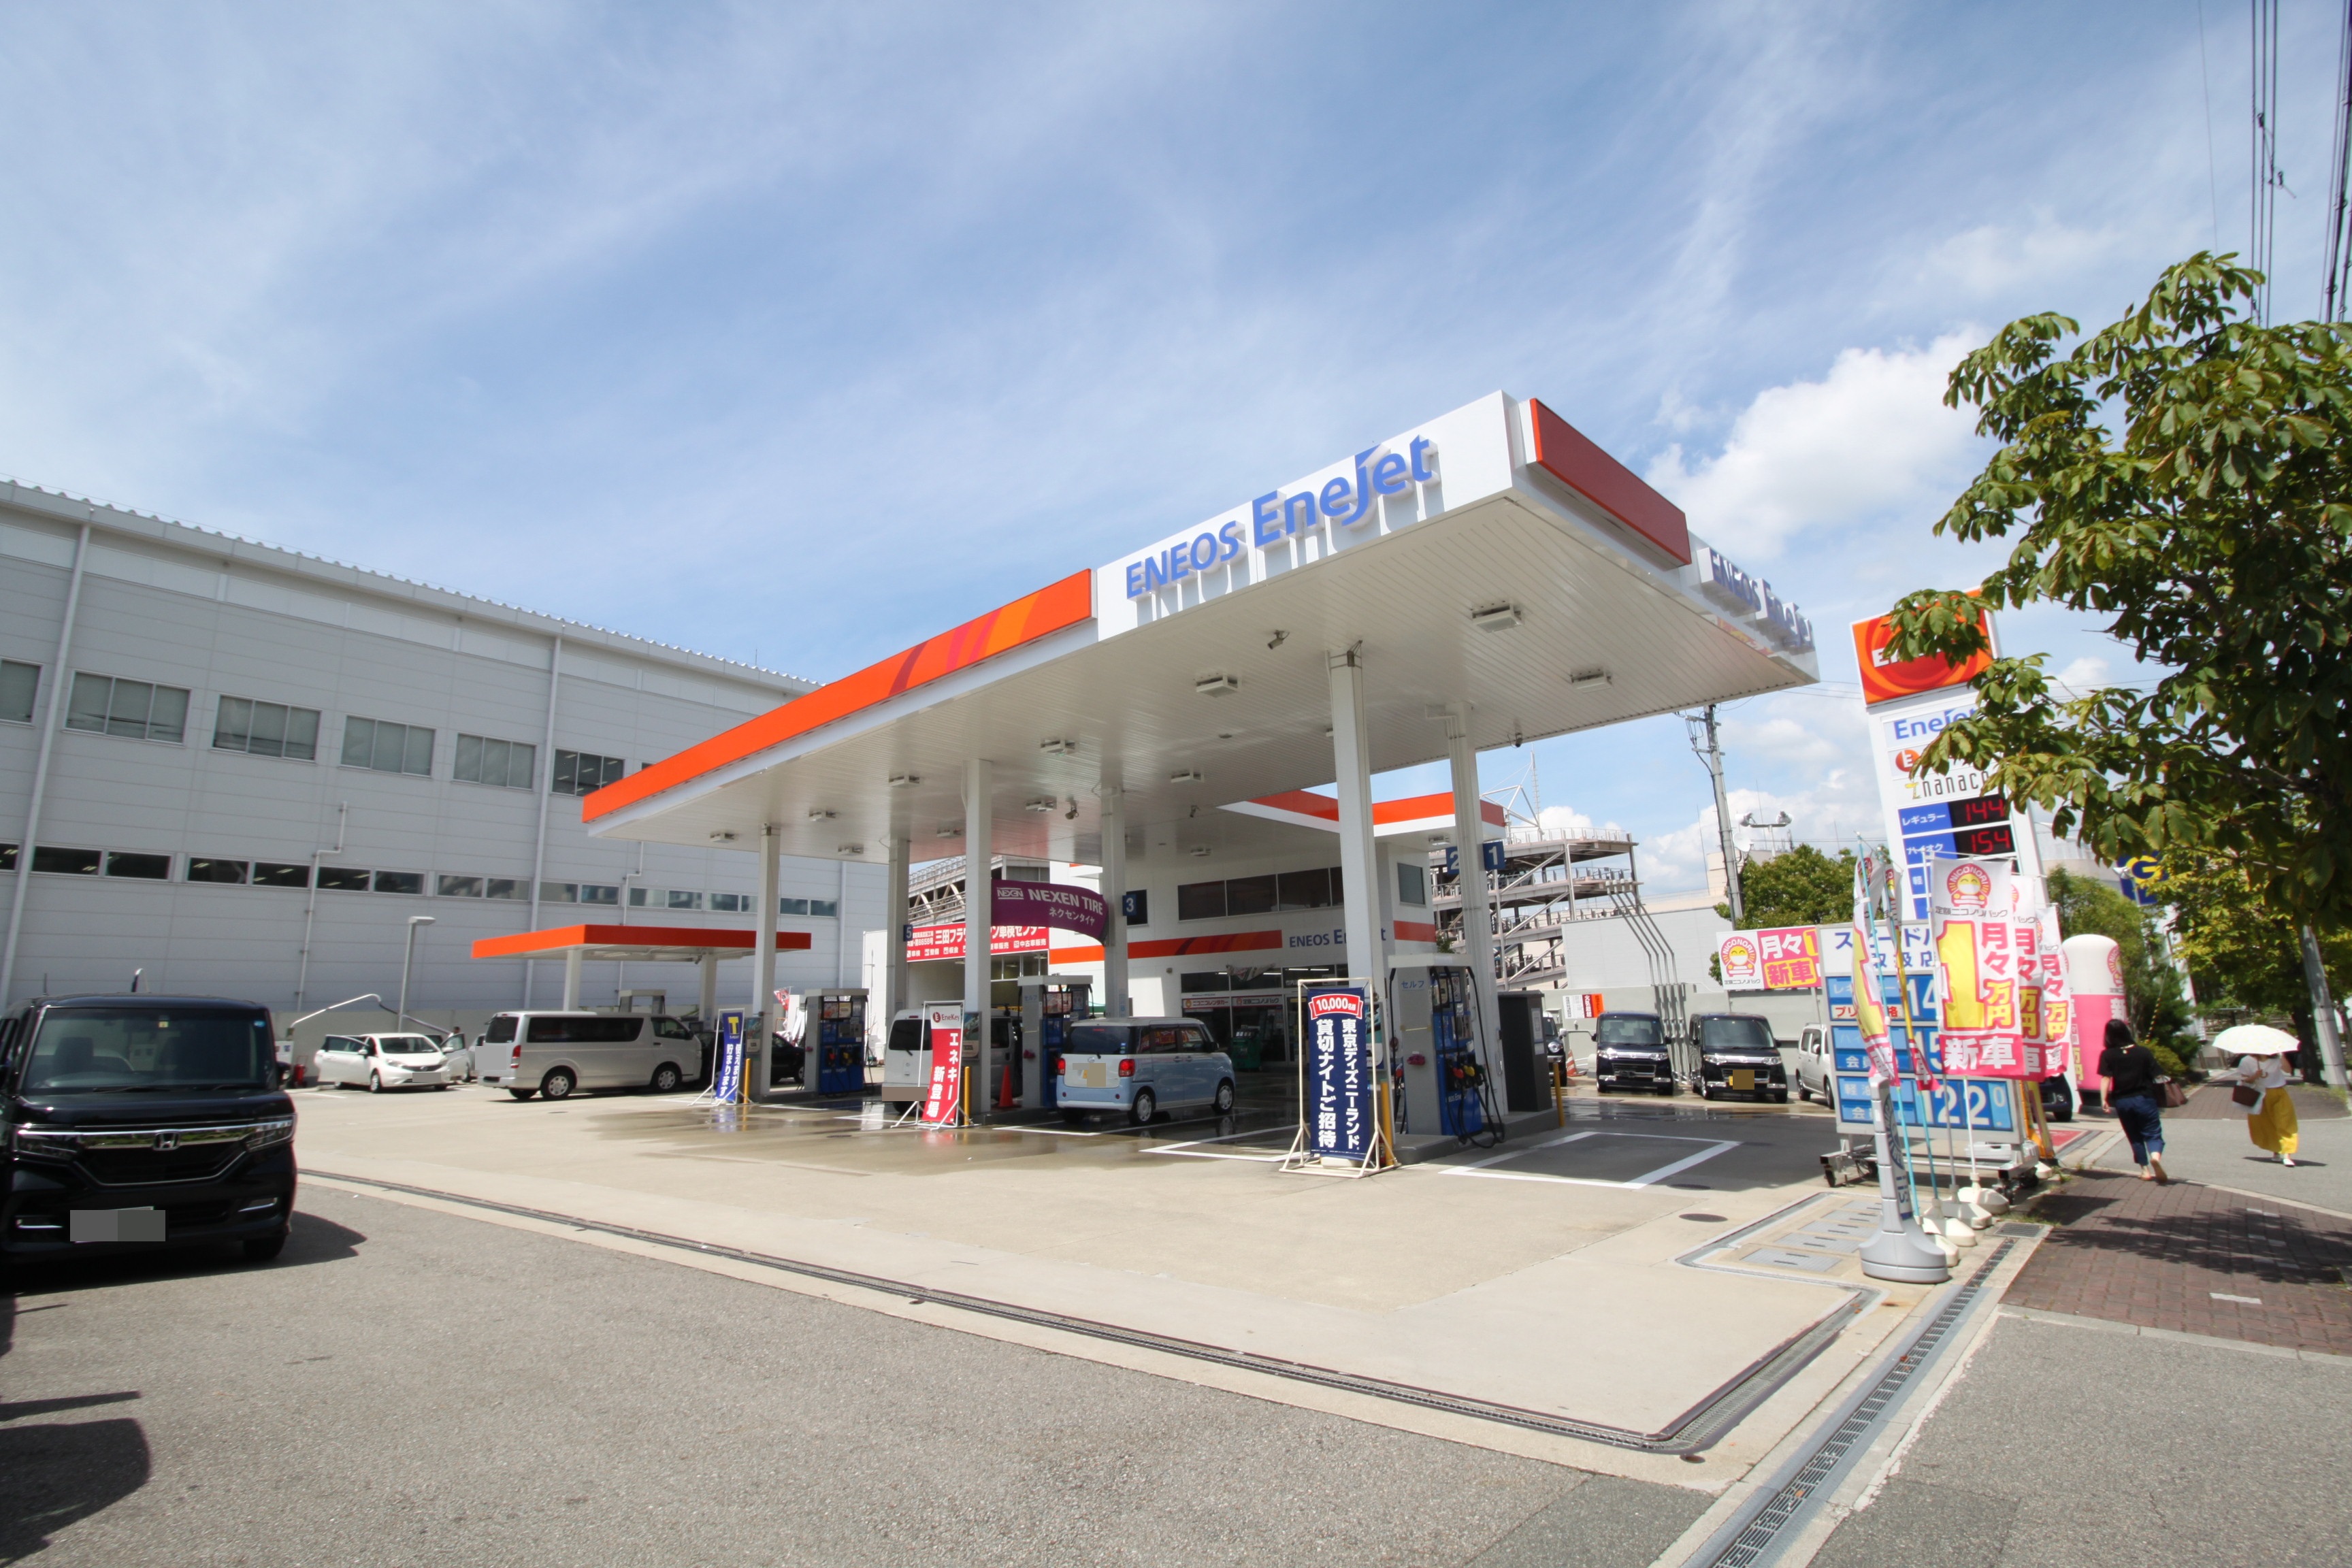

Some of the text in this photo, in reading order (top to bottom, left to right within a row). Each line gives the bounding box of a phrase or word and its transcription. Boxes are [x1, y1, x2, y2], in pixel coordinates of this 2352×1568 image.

[1126, 434, 1433, 600] ENEOS Enejet
[1902, 798, 2006, 826] レギュラー 144
[1971, 830, 2010, 853] 154
[1450, 851, 1460, 871] 2
[1488, 846, 1498, 867] 1
[1950, 866, 1989, 885] NICONORI
[1028, 888, 1104, 916] NEXEN TIRE
[1126, 897, 1134, 913] 3
[1049, 906, 1096, 926] ネクセンタイヤ
[906, 926, 913, 939] 5
[1290, 933, 1330, 948] ENEOS
[1722, 938, 1754, 955] NICONORI
[1401, 979, 1425, 990] セルフ
[1767, 964, 1814, 987] 新車
[1944, 1036, 2016, 1071] 新車
[926, 1065, 946, 1118] 新登場
[1316, 1018, 1337, 1149] 貸切ナイトご招待
